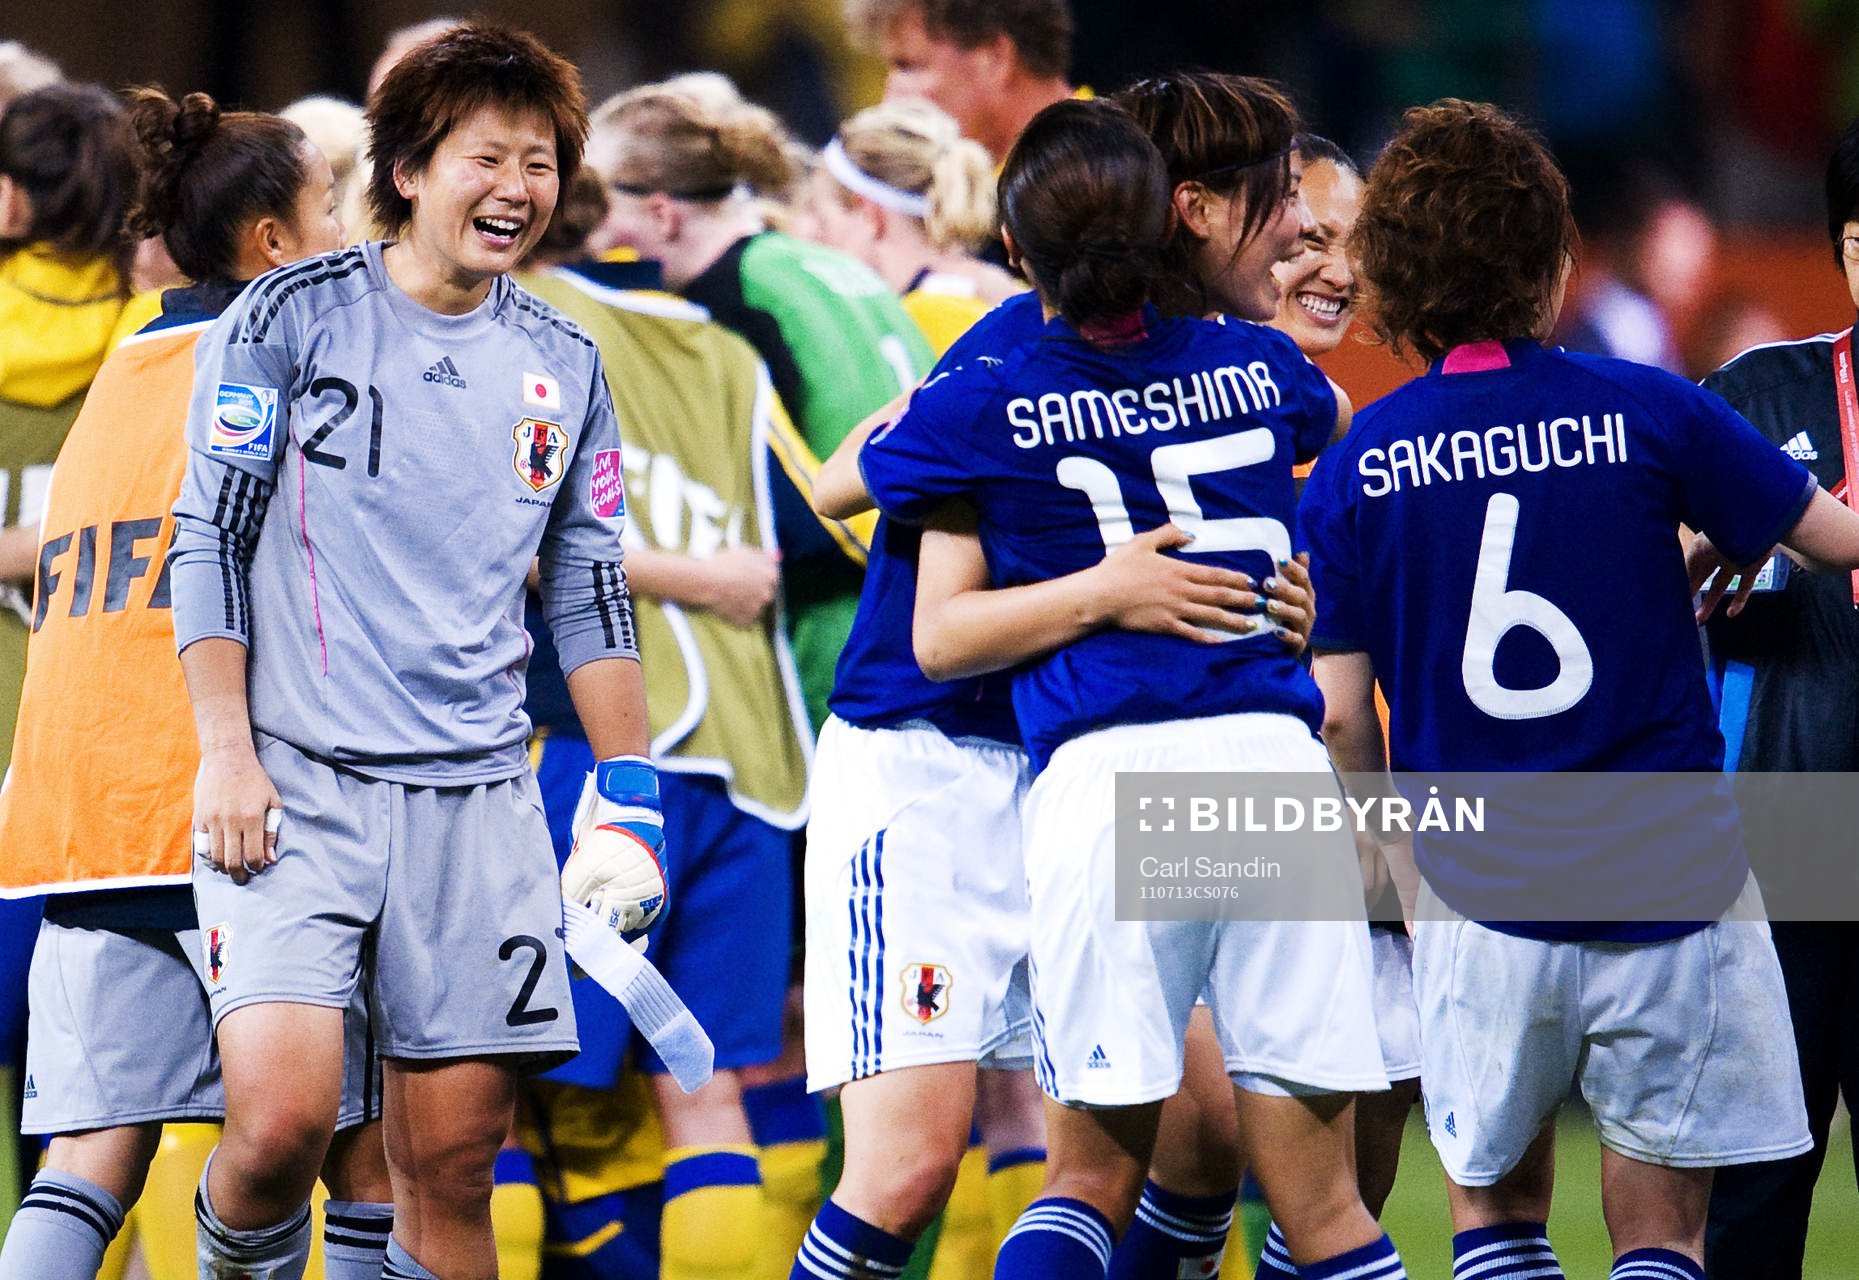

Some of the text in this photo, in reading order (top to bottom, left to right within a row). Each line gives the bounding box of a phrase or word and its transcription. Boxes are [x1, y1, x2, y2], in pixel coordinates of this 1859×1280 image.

[422, 371, 467, 389] adidas
[1006, 361, 1281, 449] SAMESHIMA
[248, 443, 268, 452] FIFA
[301, 377, 384, 478] 21
[522, 426, 558, 444] JFA
[1358, 413, 1627, 497] SAKAGUCHI
[1055, 427, 1293, 642] 15
[1462, 492, 1594, 720] 6
[499, 927, 564, 1026] 2
